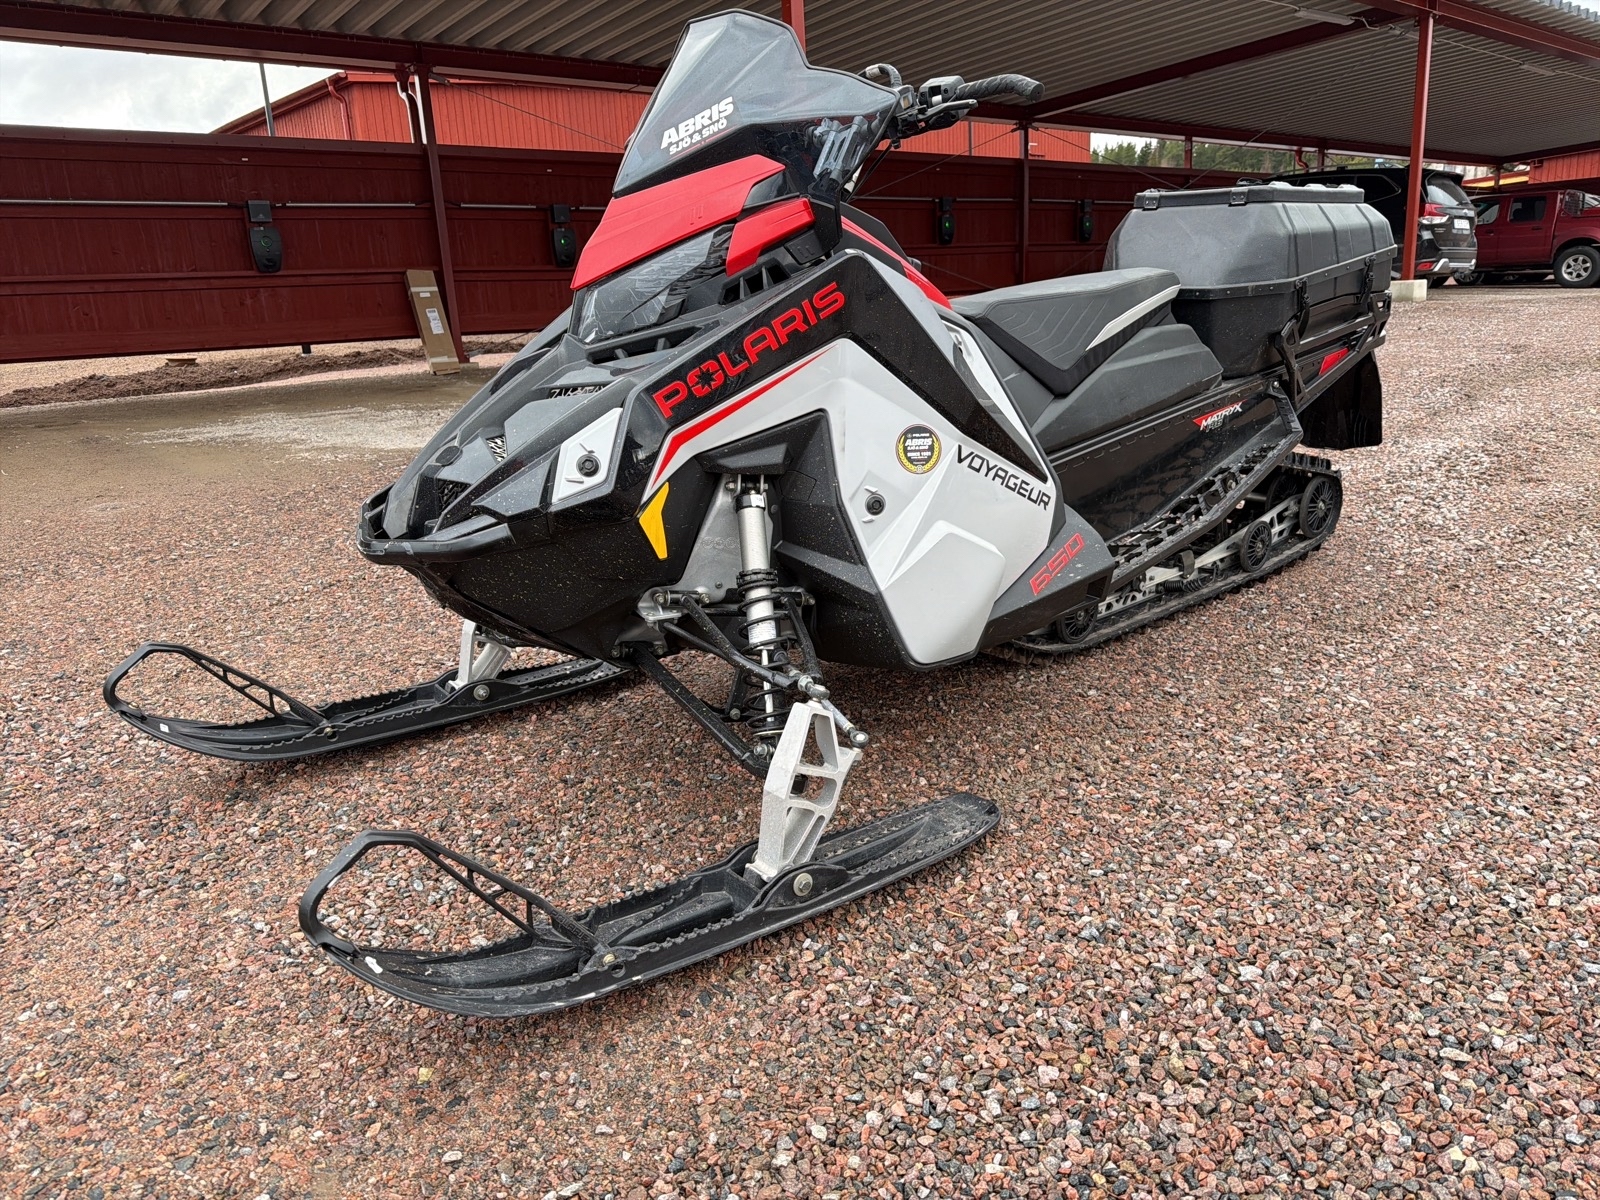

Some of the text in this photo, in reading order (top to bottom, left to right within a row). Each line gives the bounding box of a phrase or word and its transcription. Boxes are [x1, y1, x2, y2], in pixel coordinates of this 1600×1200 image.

[661, 96, 734, 149] ABRIS
[669, 117, 728, 155] SJÖ & SNÖ
[652, 281, 846, 419] POLARIS
[905, 438, 933, 447] ABRIS
[1200, 401, 1243, 431] MATRYX
[957, 443, 1052, 511] VOYAGEUR
[1029, 532, 1085, 596] 650
